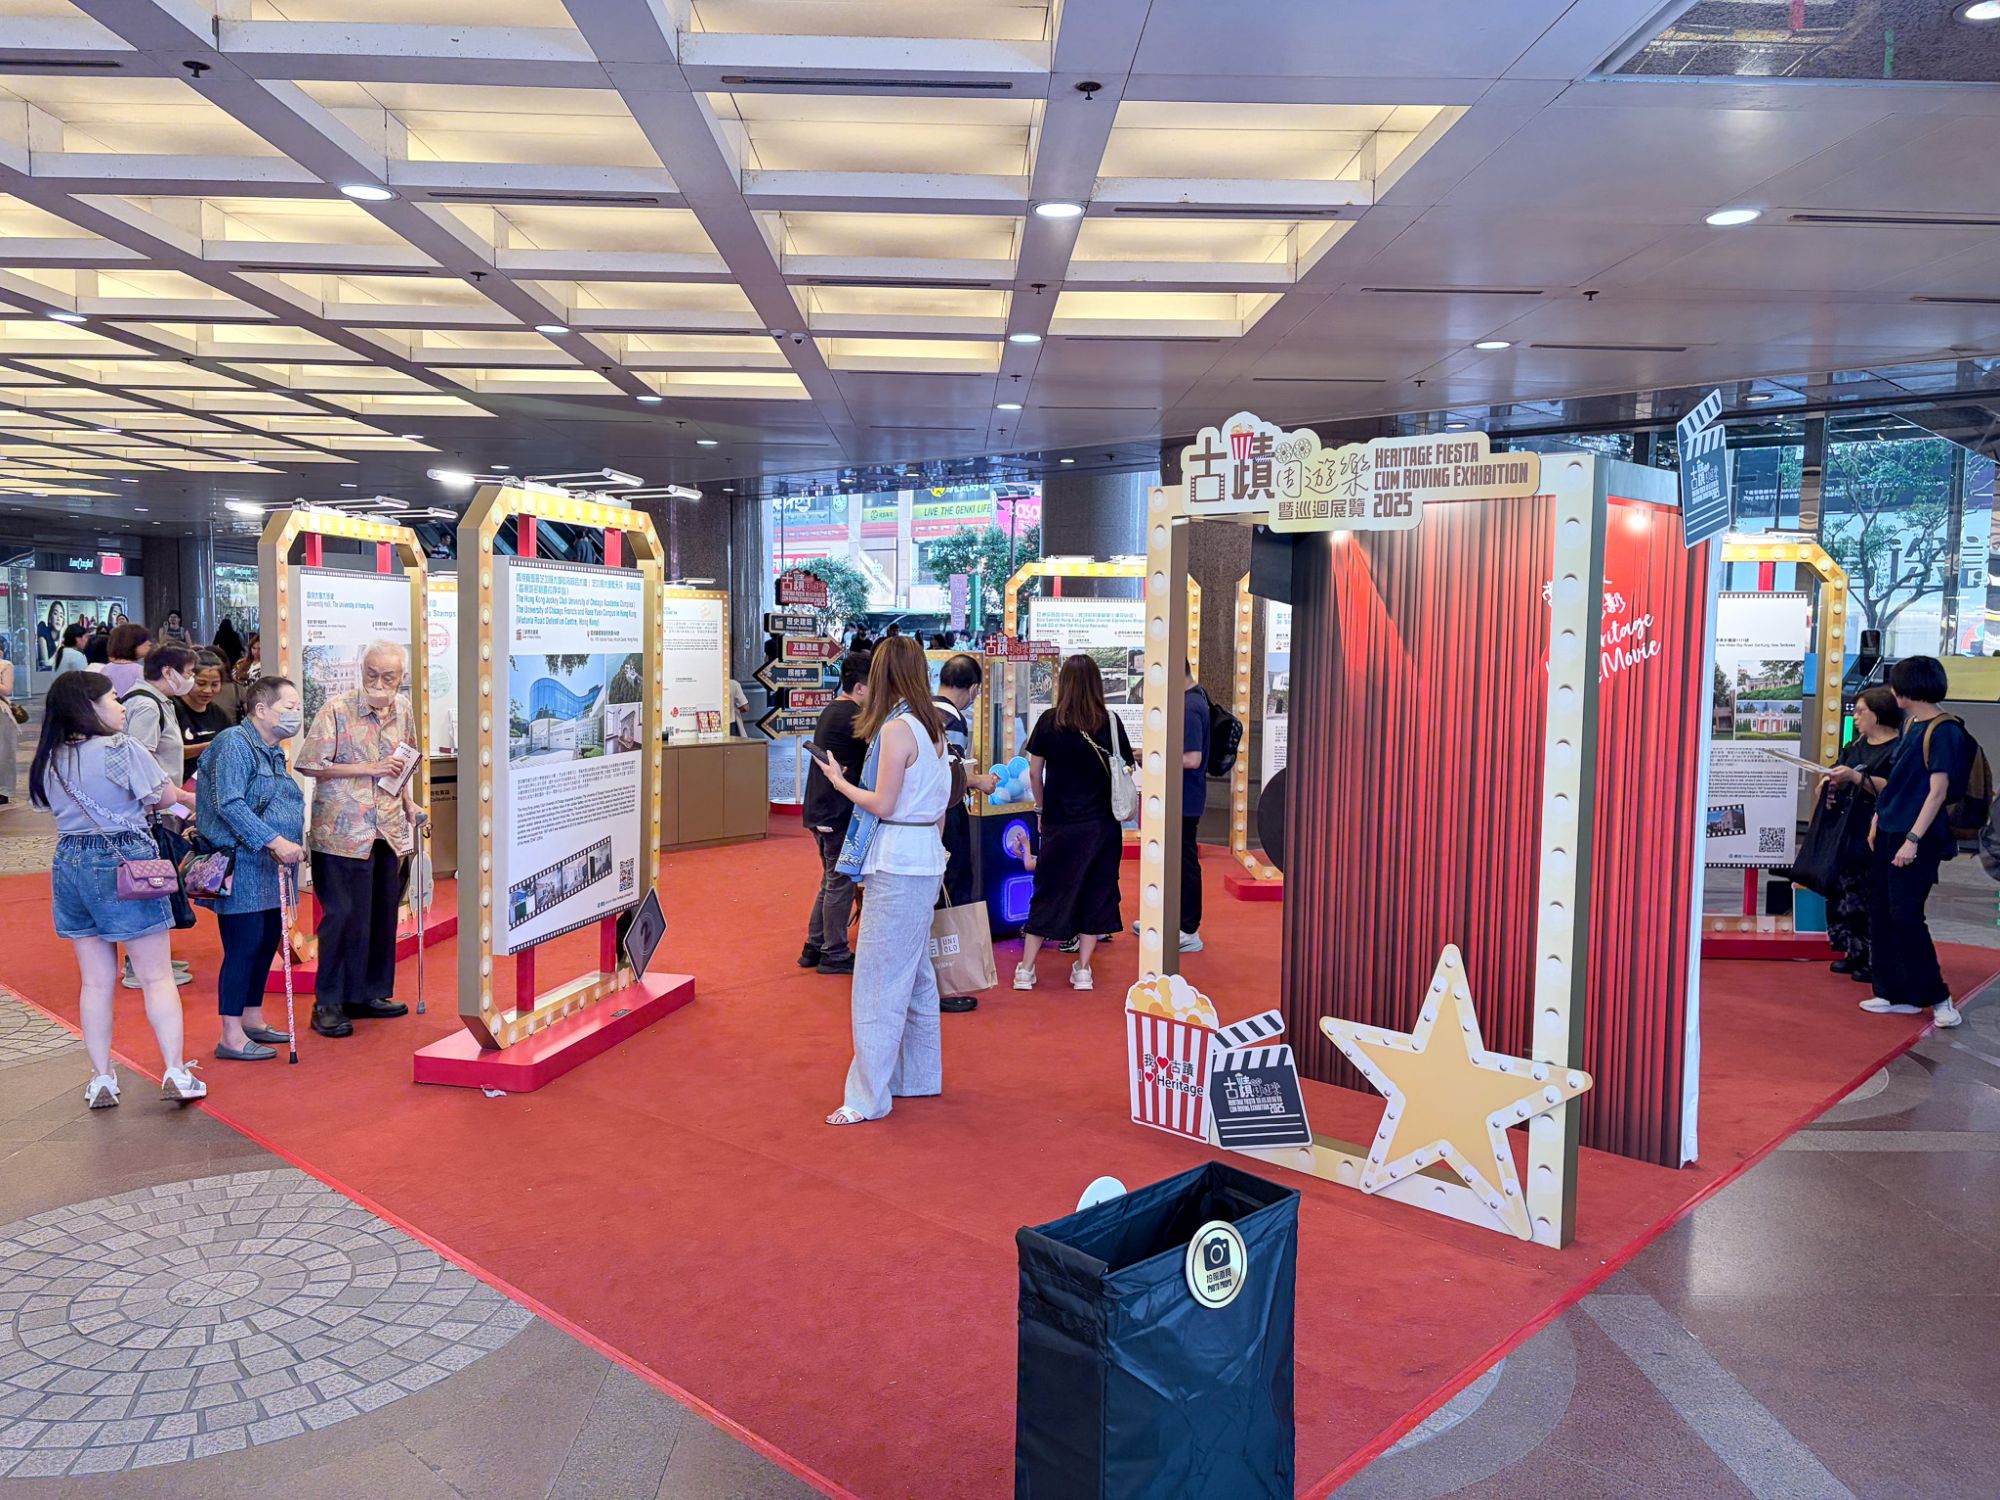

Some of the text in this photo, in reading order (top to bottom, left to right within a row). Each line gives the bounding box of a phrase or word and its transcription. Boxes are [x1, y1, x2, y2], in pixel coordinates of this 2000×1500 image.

[1375, 442, 1479, 469] HERITAGE FIESTA
[1374, 463, 1529, 491] CUM ROVING EXHIBITION
[924, 504, 991, 516] LIVE THE GENKI LIFE
[1277, 498, 1366, 521] 暨巡迴展覽
[1373, 492, 1413, 519] 2025
[433, 610, 456, 619] Stamps
[1601, 640, 1662, 679] Movie
[942, 937, 956, 946] UNI
[1143, 1053, 1194, 1077] 我 古蹟
[1156, 1074, 1204, 1097] Heritage
